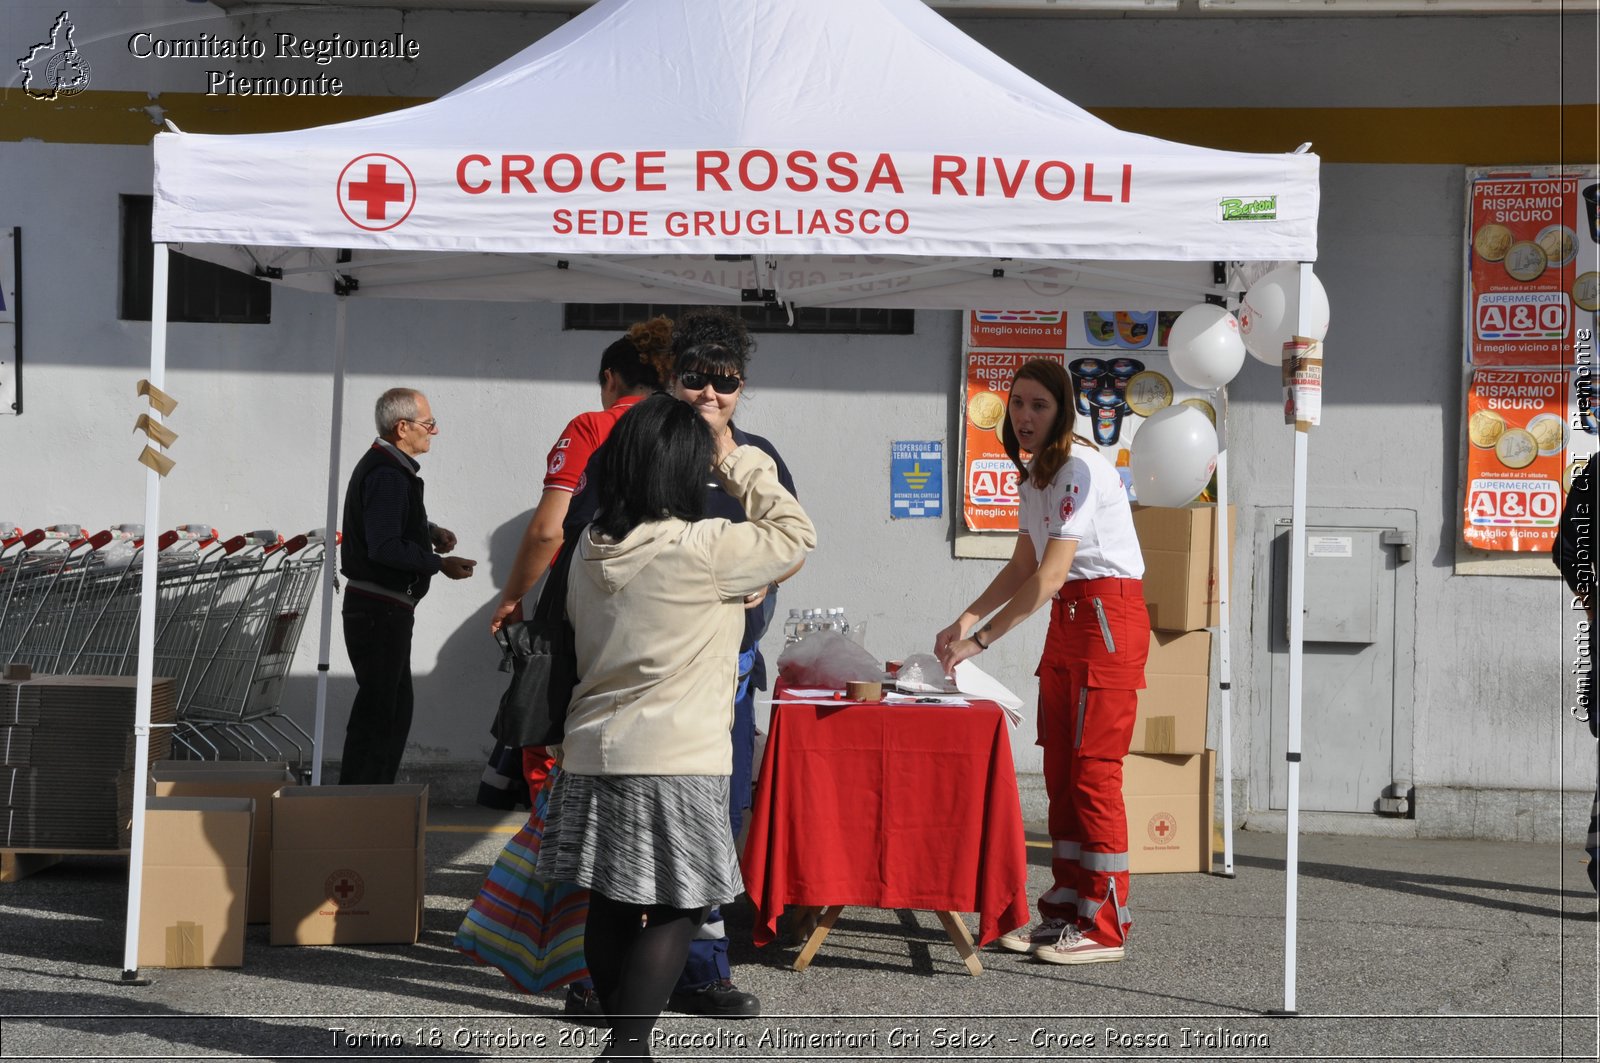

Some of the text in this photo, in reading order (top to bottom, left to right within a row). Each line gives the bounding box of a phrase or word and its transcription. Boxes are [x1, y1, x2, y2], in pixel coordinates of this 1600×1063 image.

[456, 149, 1132, 203] CROCE ROSSA RIVOLI
[1475, 182, 1576, 197] PREZZI TONDI
[1219, 195, 1276, 218] Bertoni
[1482, 196, 1563, 210] RISPARMIO
[1495, 209, 1553, 222] SICURO
[552, 208, 910, 237] SEDE GRUGLIASCO
[1482, 293, 1560, 304] SUPERMERCATI
[974, 325, 979, 333] il
[981, 326, 1013, 336] meglio
[1015, 327, 1043, 335] vicino
[1476, 343, 1482, 352] il
[1484, 343, 1517, 354] meglio
[1519, 343, 1549, 352] vicino
[969, 355, 1017, 366] PREZZI
[1524, 372, 1569, 384] TONDI
[1475, 385, 1555, 397] RISPARMIO
[1488, 398, 1545, 410] SICURO
[1474, 481, 1551, 490] SUPERMERCATI
[1473, 492, 1556, 515] A&O
[968, 507, 973, 515] il
[975, 508, 1006, 518] meglio
